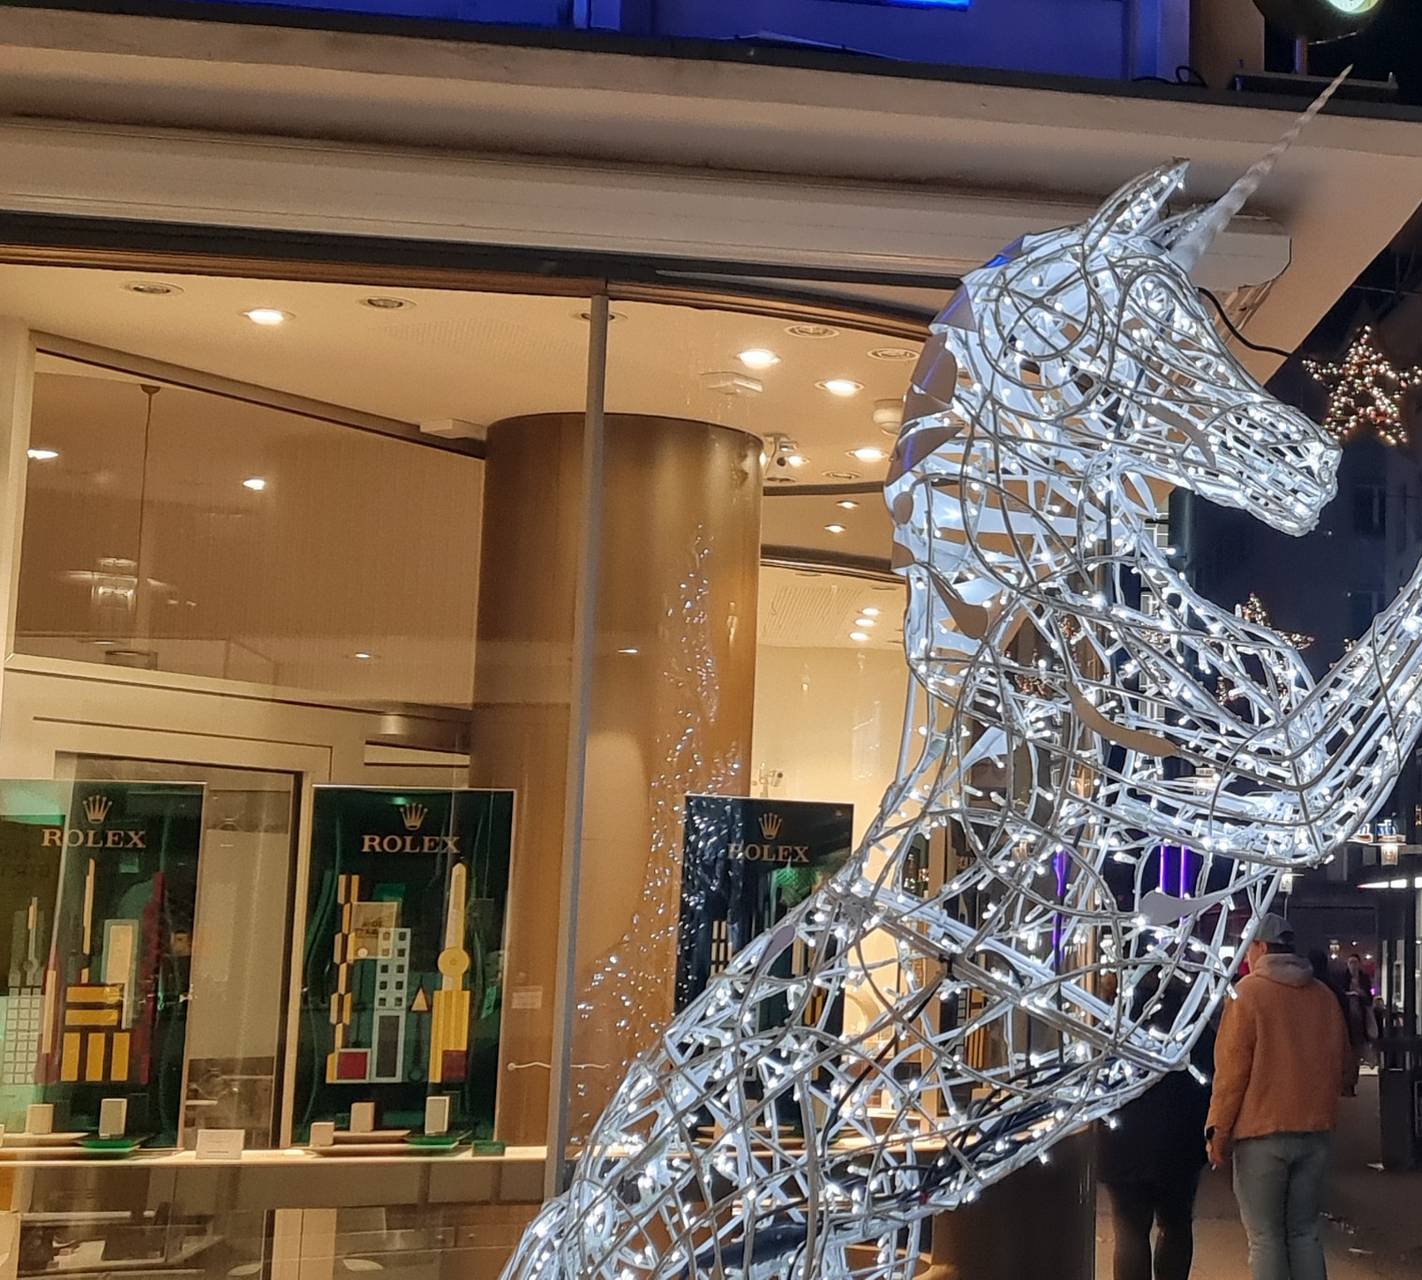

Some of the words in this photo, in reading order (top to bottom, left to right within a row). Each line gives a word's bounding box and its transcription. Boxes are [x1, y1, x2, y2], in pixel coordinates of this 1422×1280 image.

[41, 828, 147, 849] ROLEX
[361, 834, 460, 854] ROLEX
[728, 843, 809, 862] ROLEX
